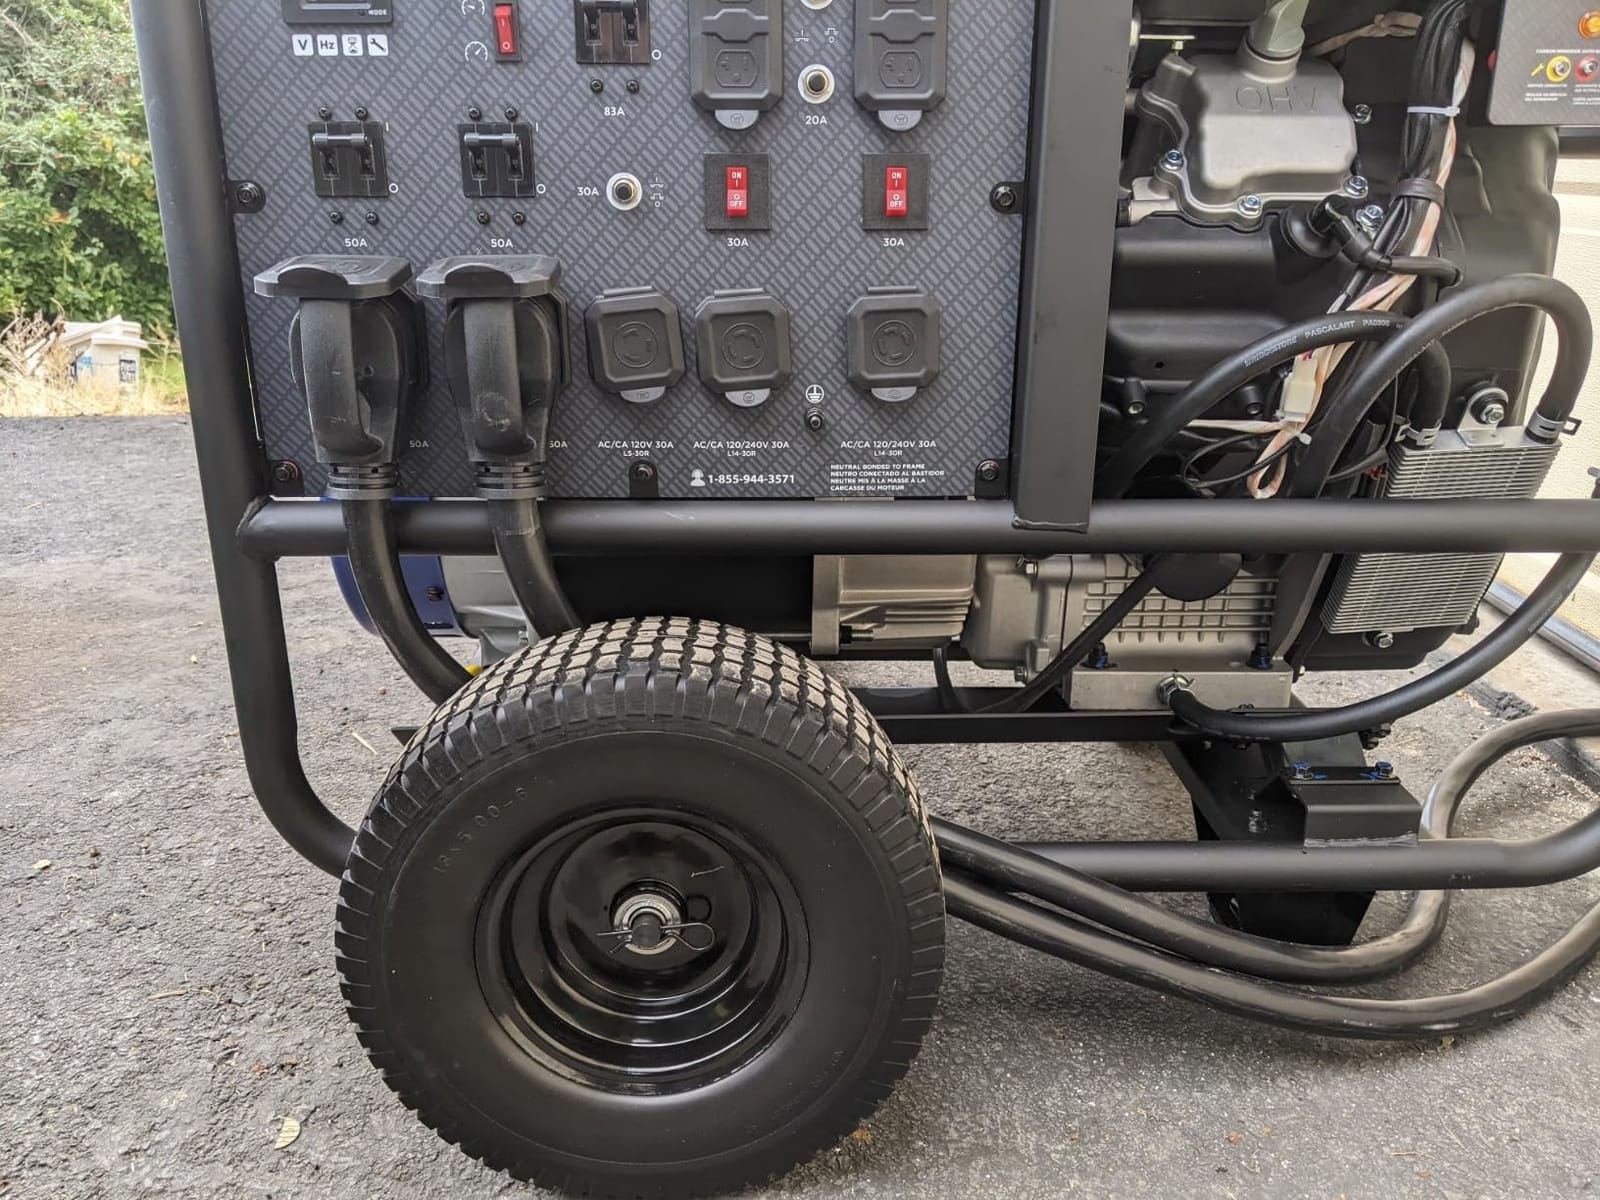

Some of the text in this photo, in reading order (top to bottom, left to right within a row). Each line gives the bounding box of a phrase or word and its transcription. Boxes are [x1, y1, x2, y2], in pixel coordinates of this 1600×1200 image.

[298, 39, 307, 50] V
[320, 40, 335, 49] Hz
[1235, 86, 1317, 112] OHV
[604, 106, 625, 116] 83A
[805, 115, 828, 125] 20A
[731, 171, 742, 179] ON
[577, 187, 599, 196] 30A
[729, 200, 744, 208] OFF
[889, 200, 904, 208] OFF
[344, 238, 368, 248] 50A
[490, 238, 514, 248] 50A
[727, 237, 749, 247] 30A
[883, 237, 905, 247] 30A
[1304, 320, 1356, 339] PASCALART
[409, 440, 429, 448] 50A
[549, 440, 568, 448] 50A
[598, 440, 674, 449] AC/CA 120V 30A
[693, 440, 790, 450] AC/CA 120/240V 30A
[840, 440, 937, 449] AC/CA 120/240V 30A
[874, 449, 903, 457] L14-30R
[708, 474, 795, 484] 1-855-944-3571
